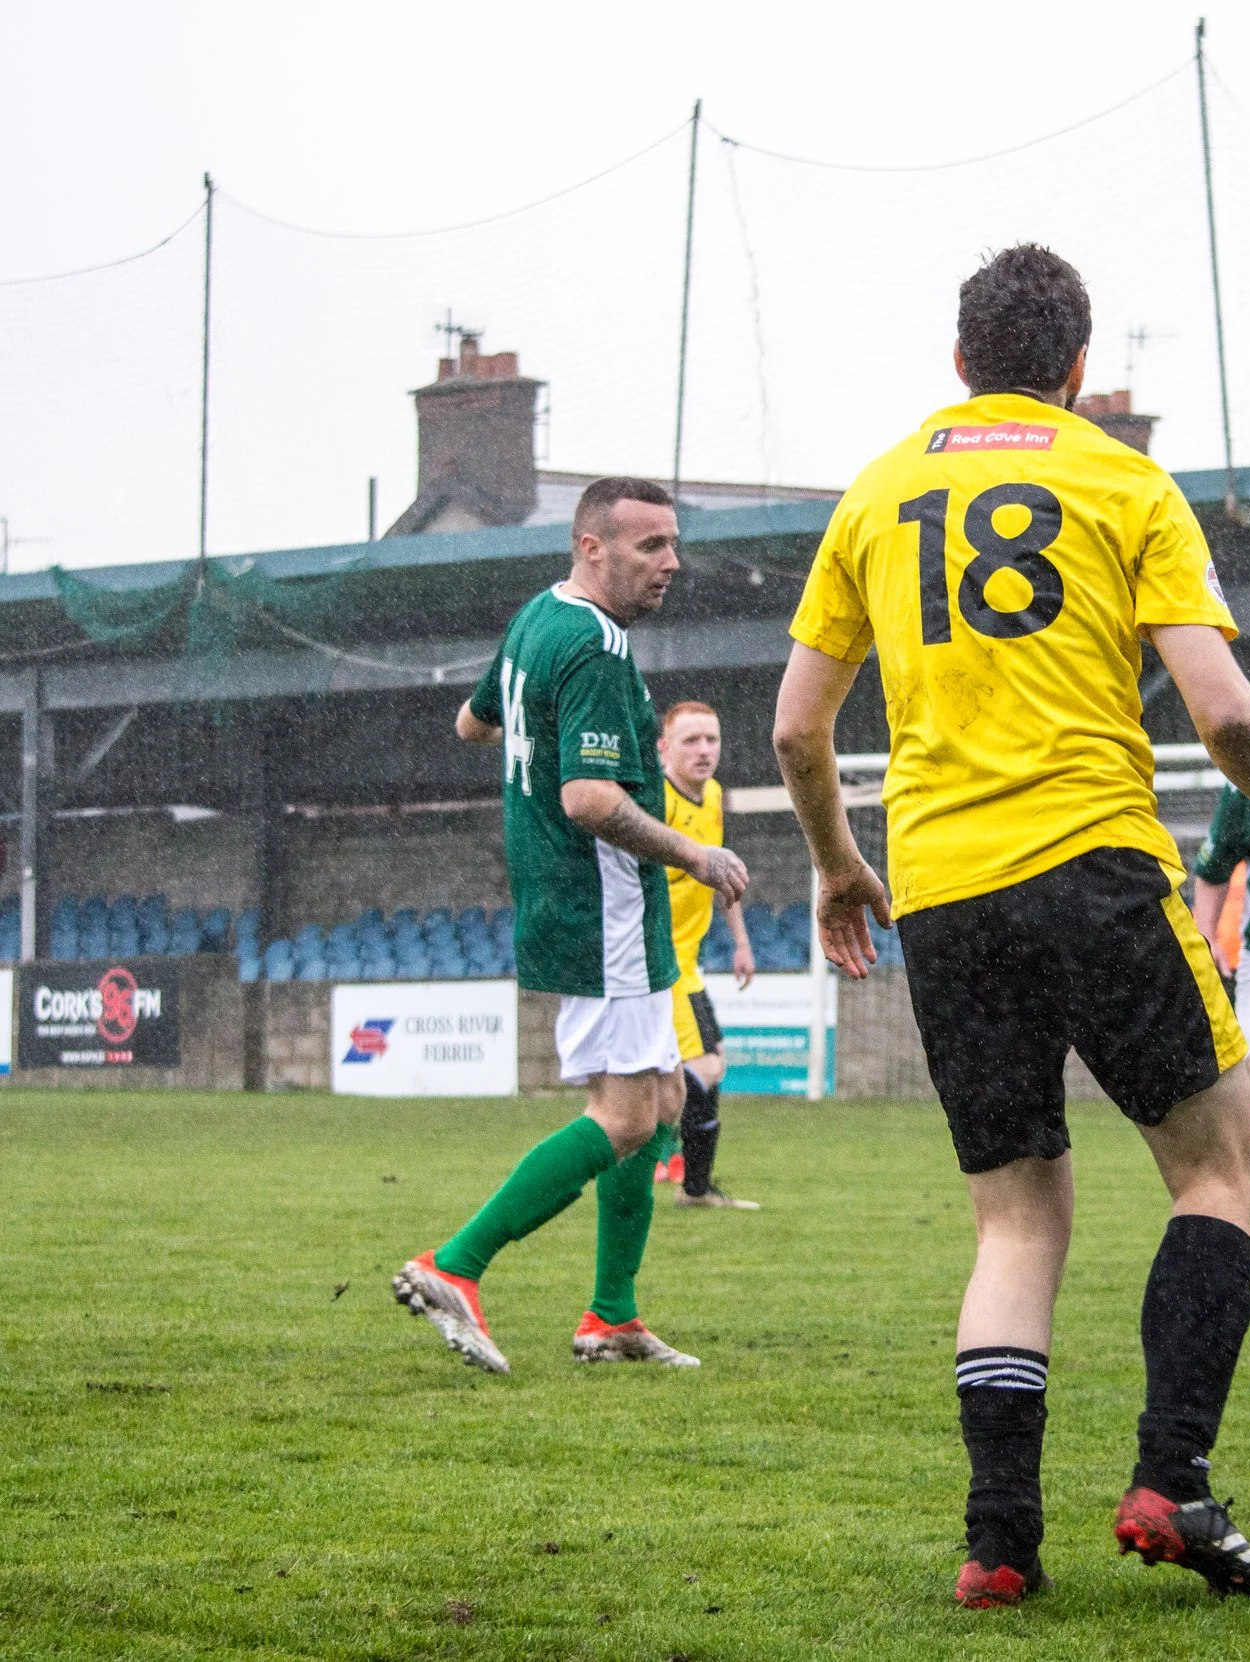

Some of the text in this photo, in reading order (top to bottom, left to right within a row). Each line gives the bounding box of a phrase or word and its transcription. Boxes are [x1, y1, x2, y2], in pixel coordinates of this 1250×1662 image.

[931, 432, 1049, 450] The Red Cove Inn
[898, 483, 1065, 646] 18
[580, 731, 621, 751] DM
[132, 988, 162, 1018] FM
[405, 1013, 503, 1034] CROSS RIVER
[425, 1043, 485, 1062] FERRIES
